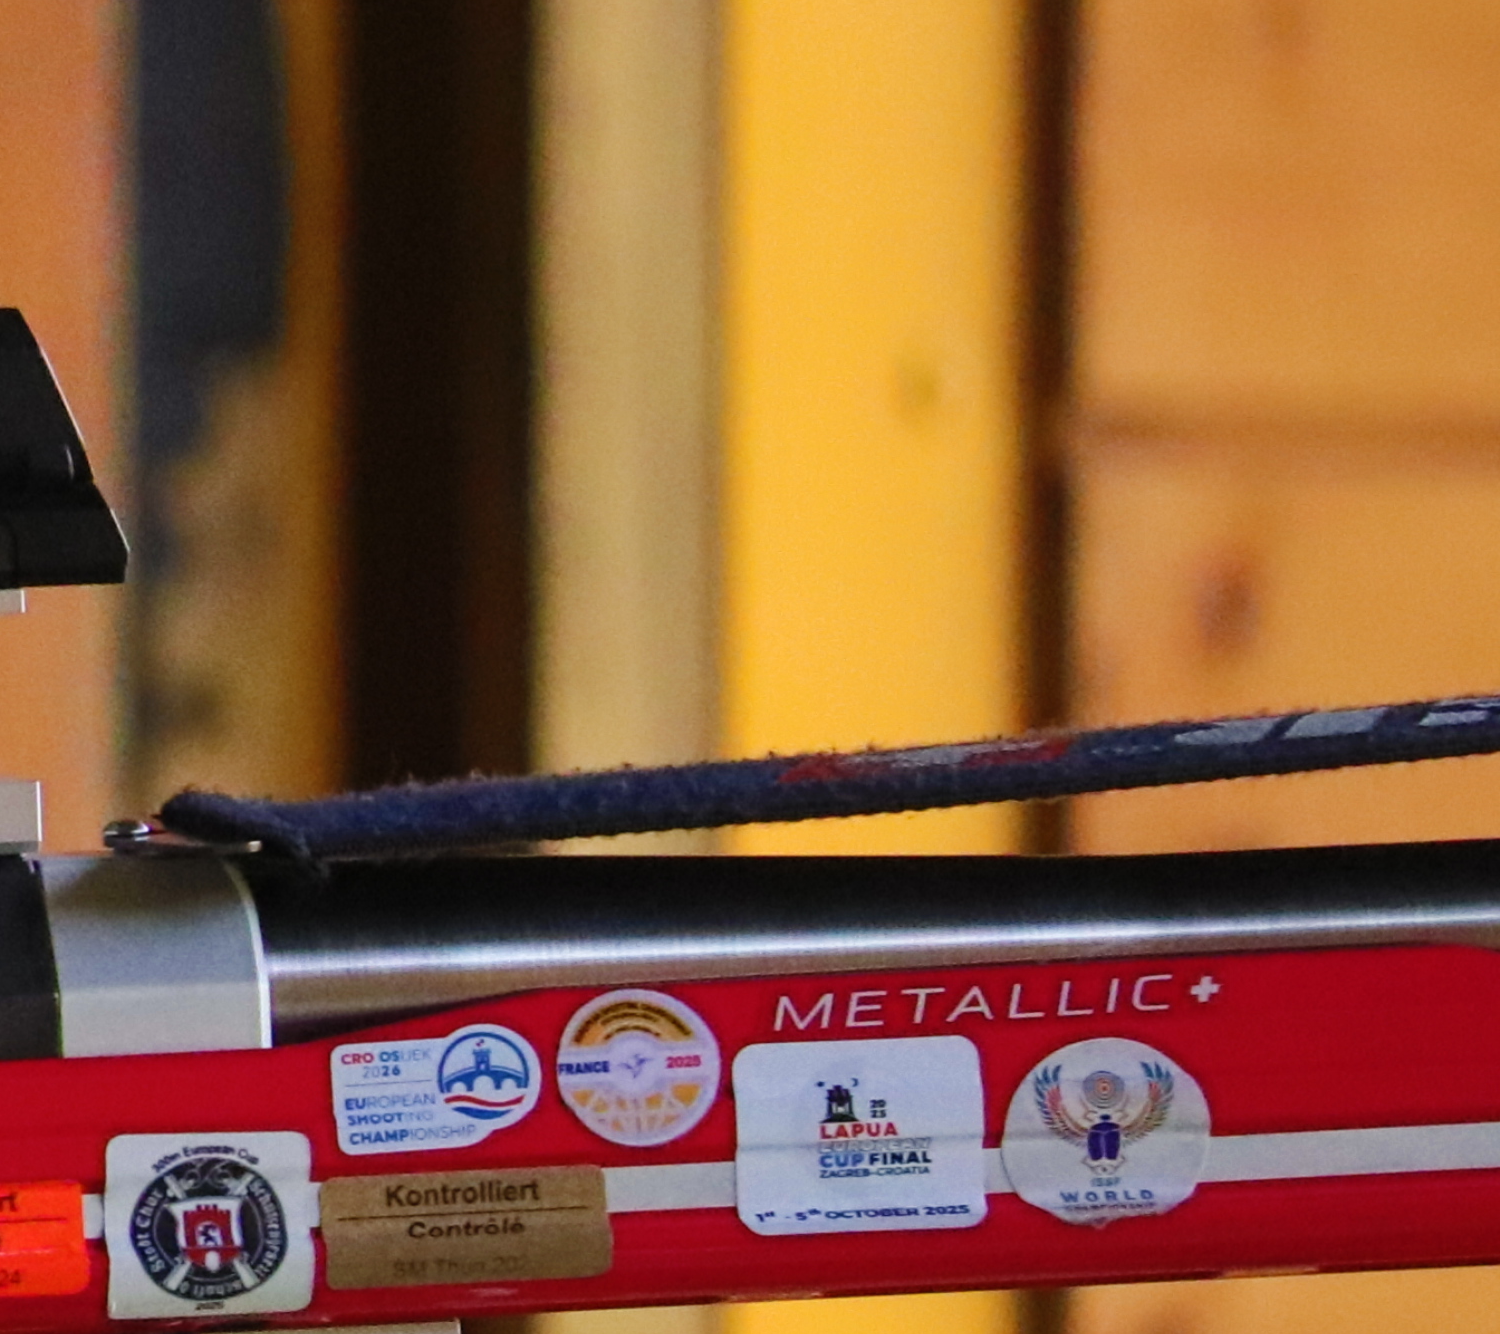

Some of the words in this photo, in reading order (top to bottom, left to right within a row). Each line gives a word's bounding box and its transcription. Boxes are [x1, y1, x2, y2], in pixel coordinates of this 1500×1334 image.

[772, 973, 1174, 1032] METALLIC
[340, 1051, 375, 1066] CRO
[378, 1048, 433, 1064] OSIJEK
[362, 1064, 402, 1079] 2026
[557, 1060, 611, 1076] FRANCE
[344, 1092, 437, 1111] EUROPEAN
[347, 1109, 434, 1127] SHOOTING
[349, 1123, 477, 1146] CHAMPIONSHIP
[819, 1122, 899, 1139] LAPUA
[819, 1152, 866, 1168] CUP
[869, 1150, 932, 1166] FINAL
[385, 1178, 541, 1208] Kontrolliert
[1058, 1188, 1155, 1204] WORLD
[824, 1207, 919, 1220] OCTOBER
[922, 1203, 971, 1217] 2025
[407, 1217, 526, 1240] Contrôlé
